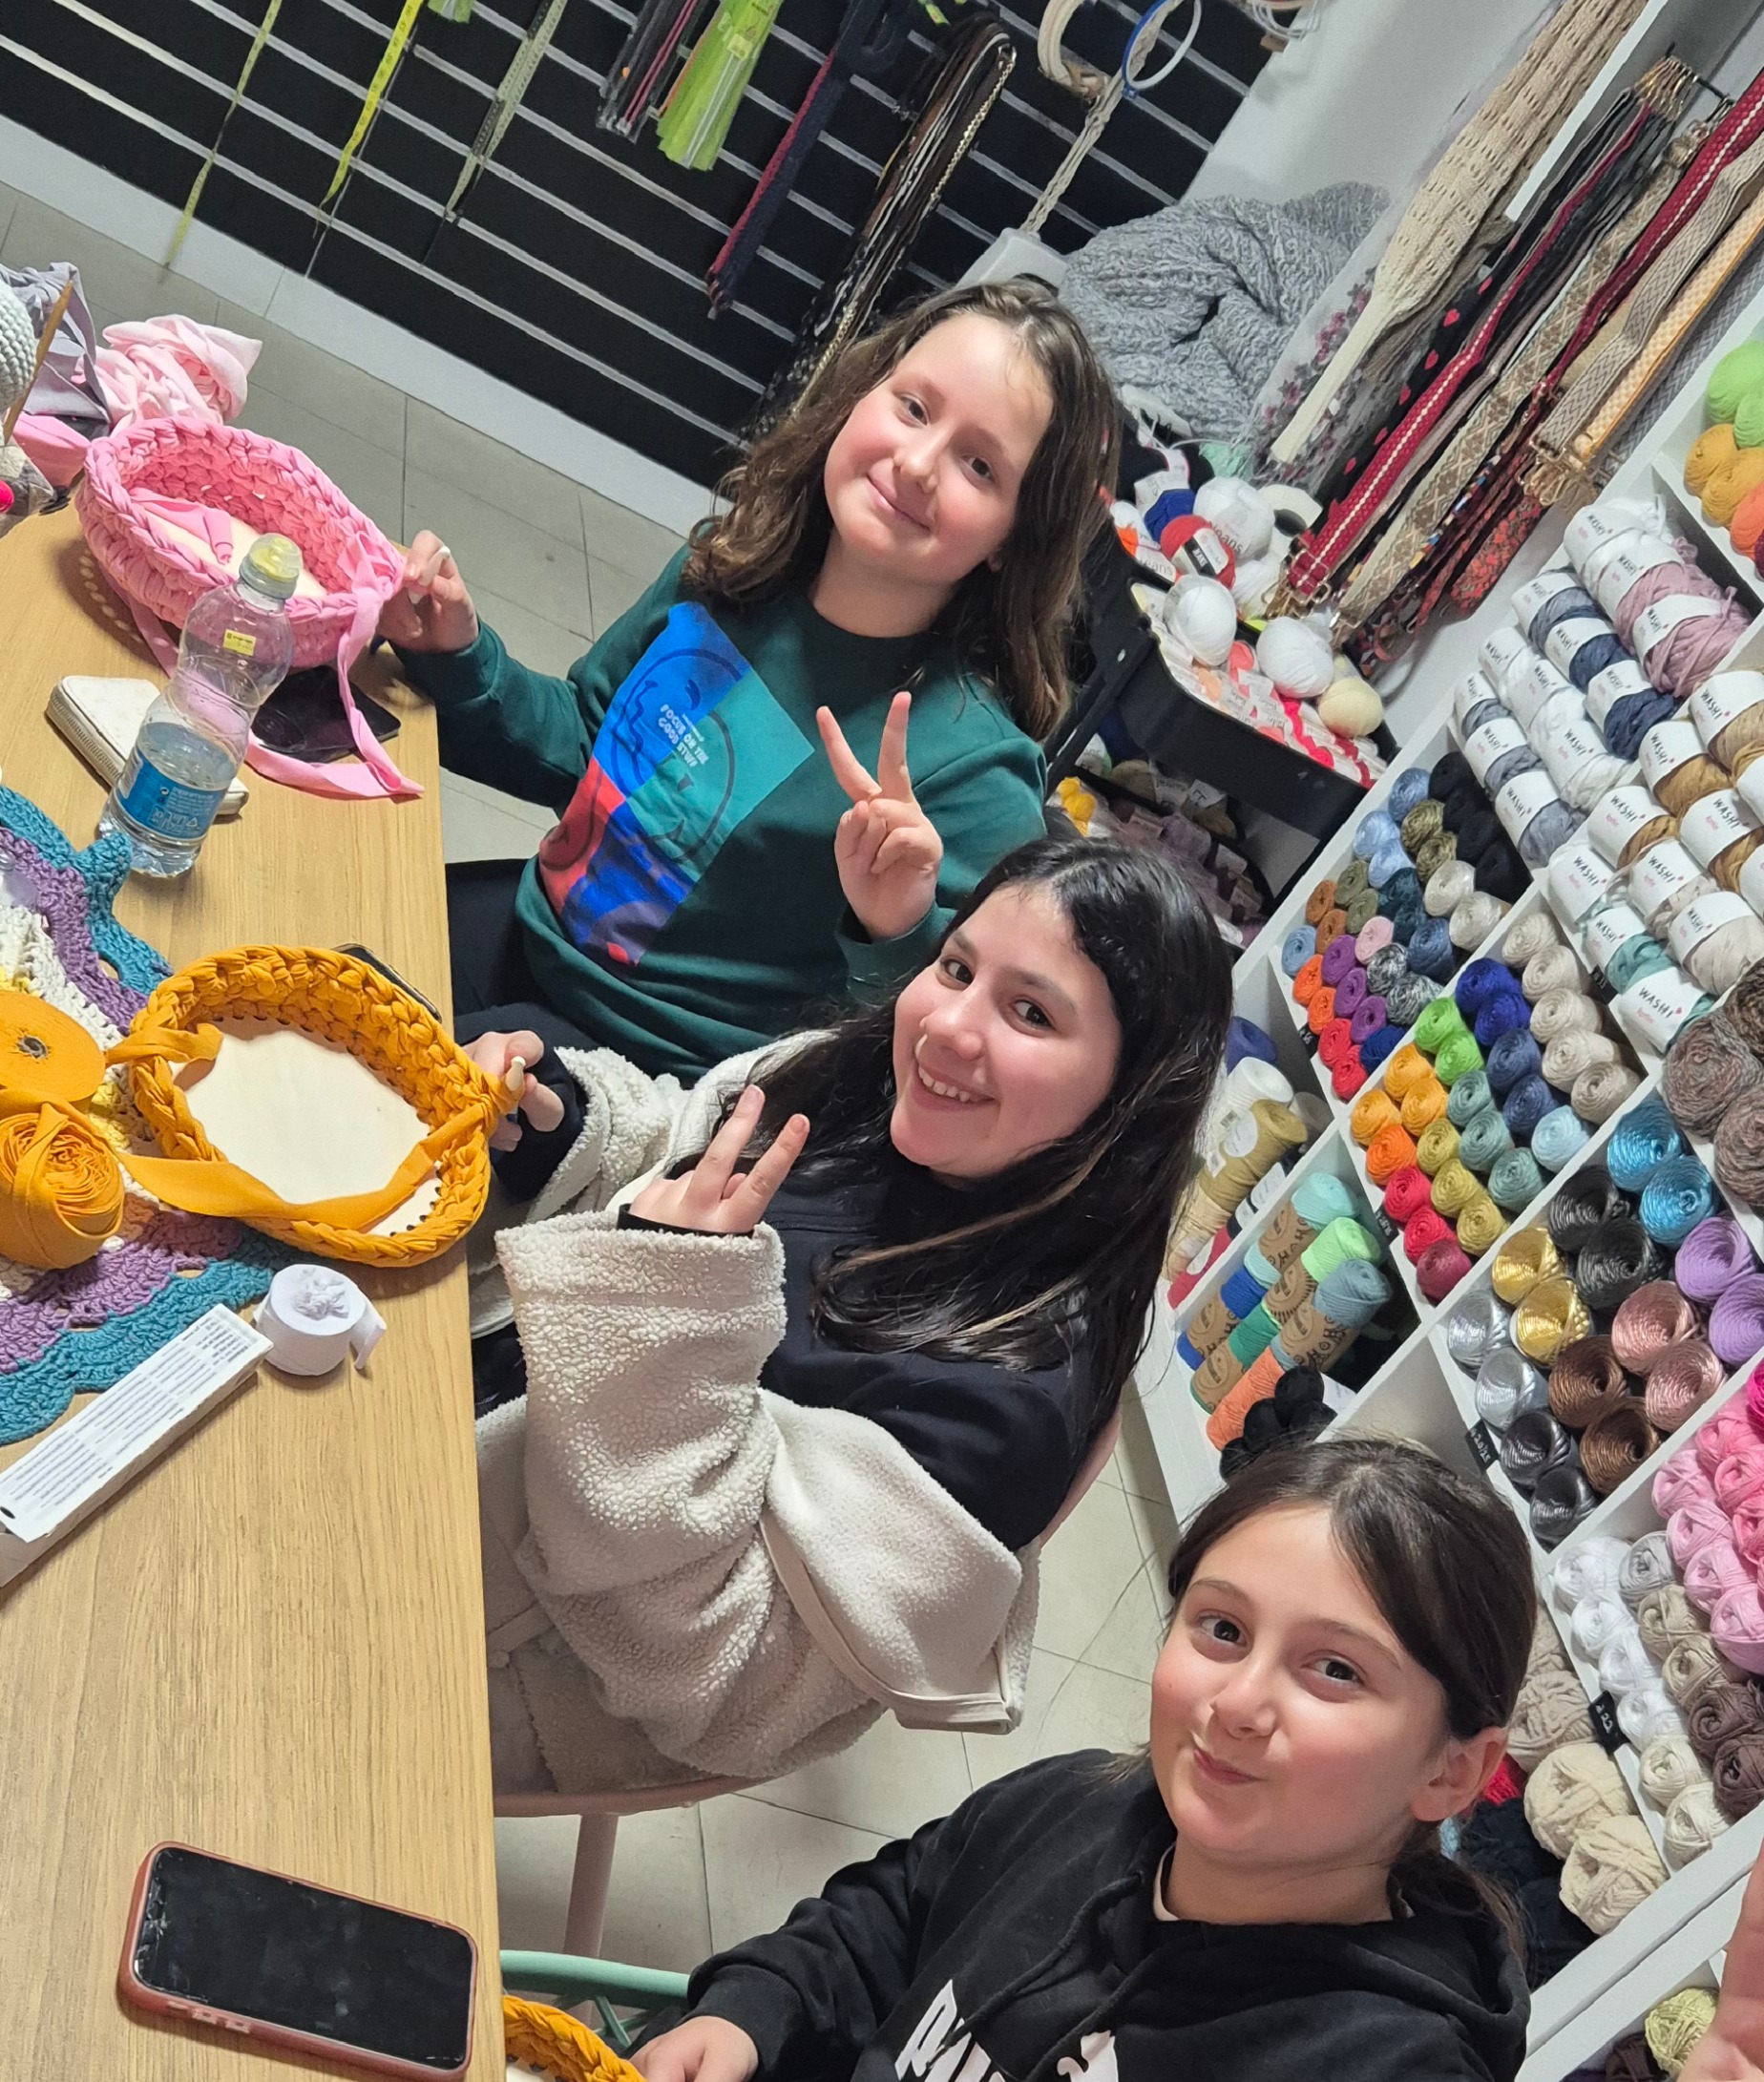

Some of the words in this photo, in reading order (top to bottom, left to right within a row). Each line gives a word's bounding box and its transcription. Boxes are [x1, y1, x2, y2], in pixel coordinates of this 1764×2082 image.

[1700, 689, 1722, 719] WASHI
[1564, 730, 1587, 755] WASHI
[1650, 732, 1670, 766] WASHI
[1507, 788, 1526, 817] WASHI
[1611, 795, 1638, 822] WASHI
[1713, 798, 1740, 828] WASHI
[1573, 856, 1599, 886] WASHI
[1648, 855, 1675, 883] WASHI
[1595, 919, 1617, 942] WASHI
[1638, 987, 1672, 1018] WASHI
